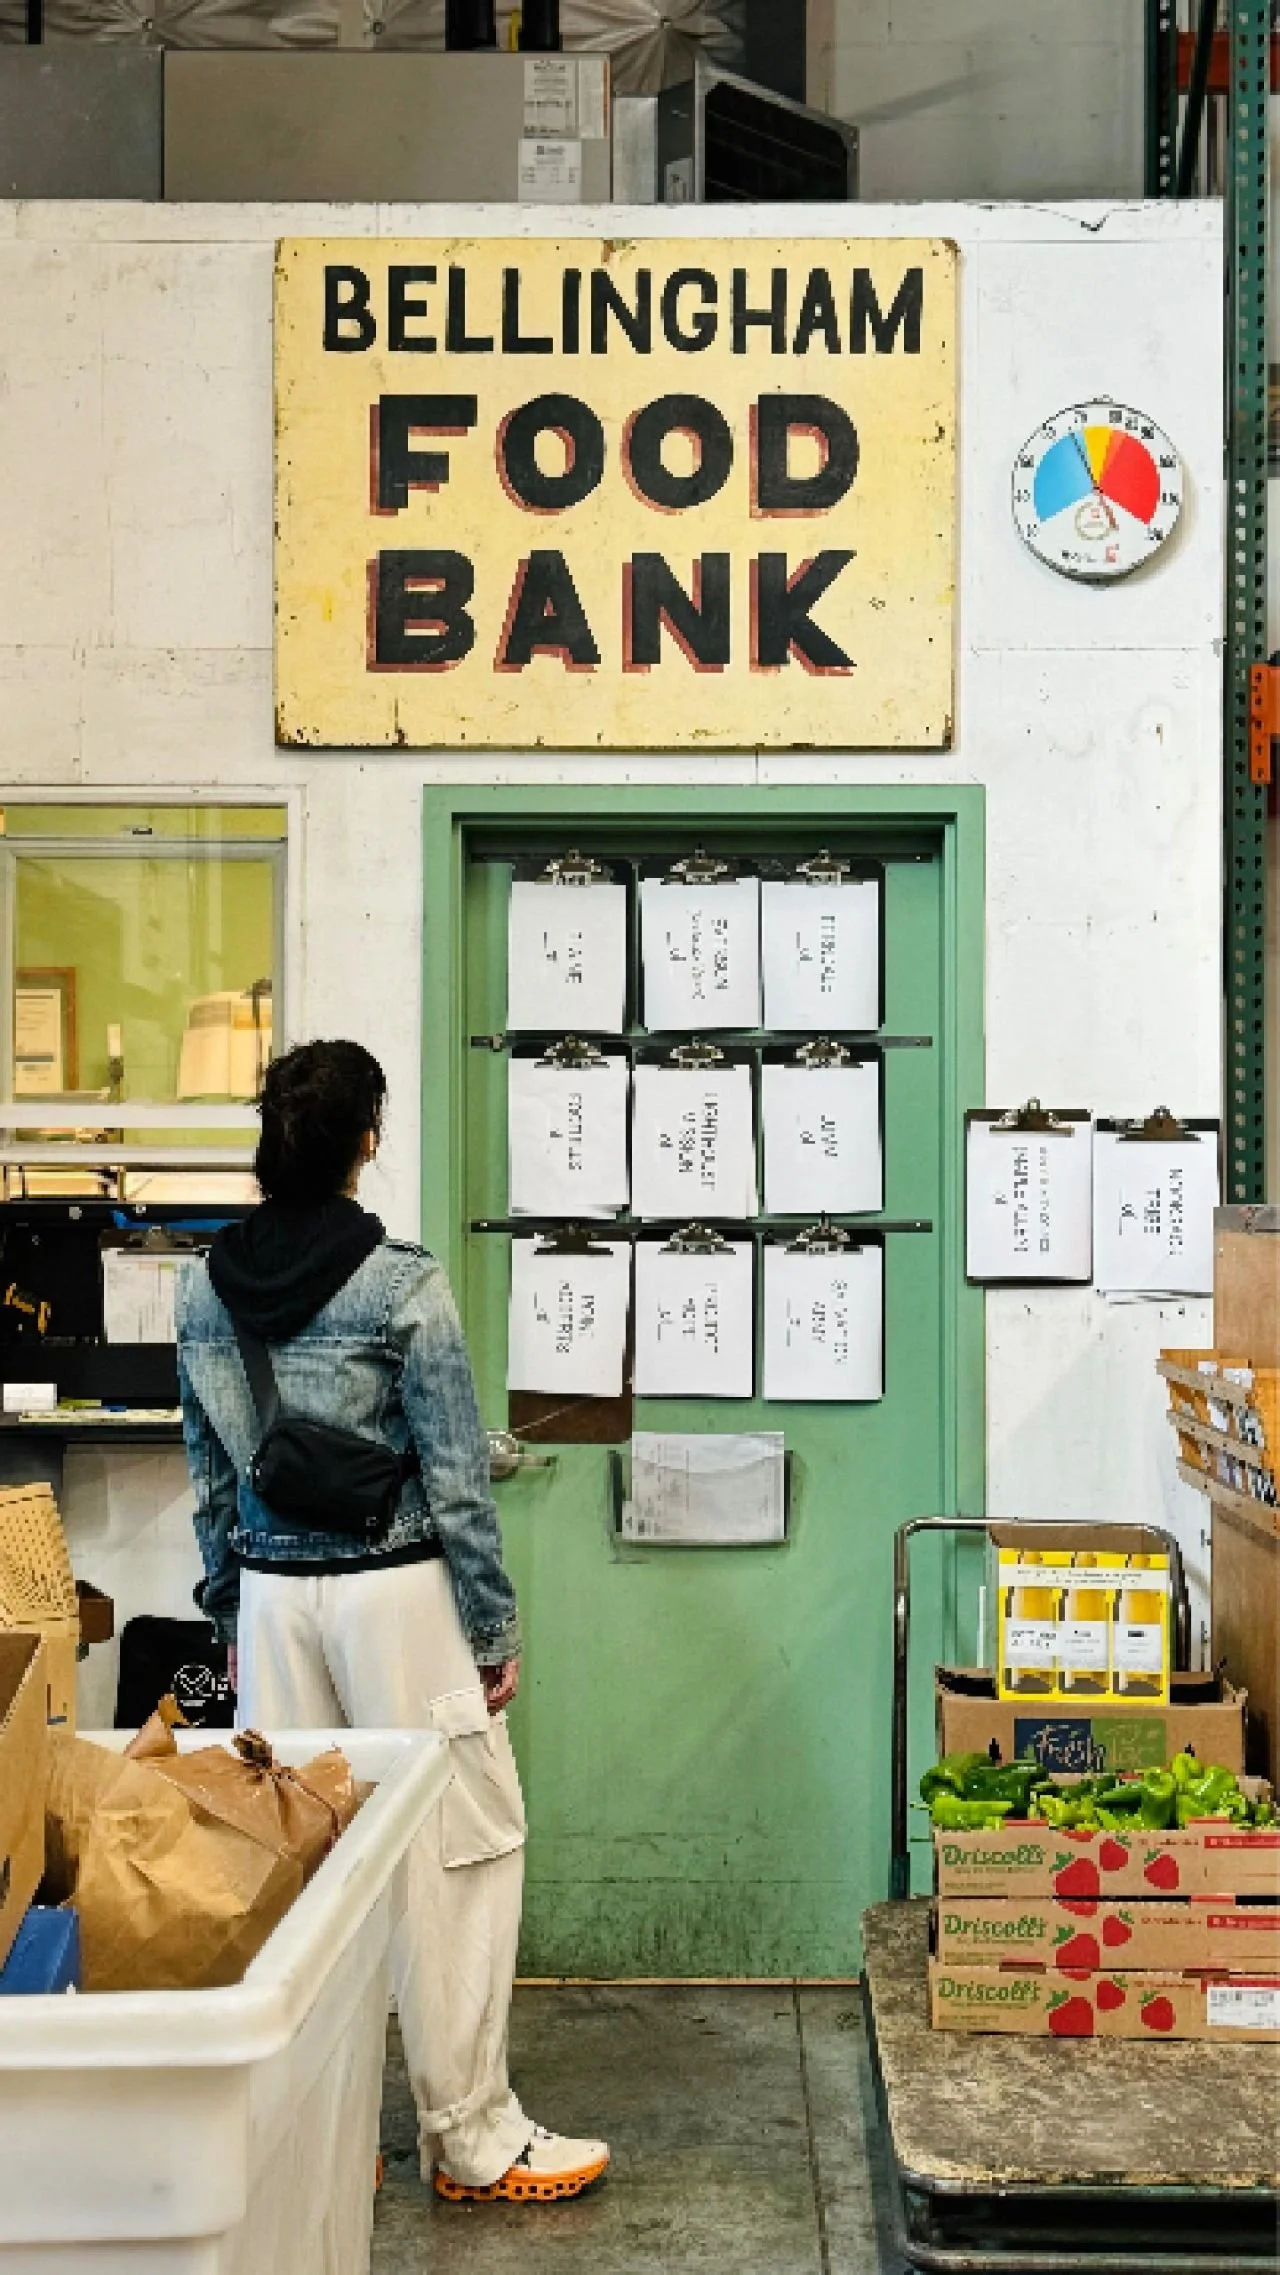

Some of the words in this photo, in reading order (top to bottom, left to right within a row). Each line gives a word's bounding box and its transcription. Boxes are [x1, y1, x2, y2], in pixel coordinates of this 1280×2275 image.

[323, 265, 923, 354] BELLINGHAM
[369, 392, 860, 519] FOOD
[366, 550, 857, 676] BANK
